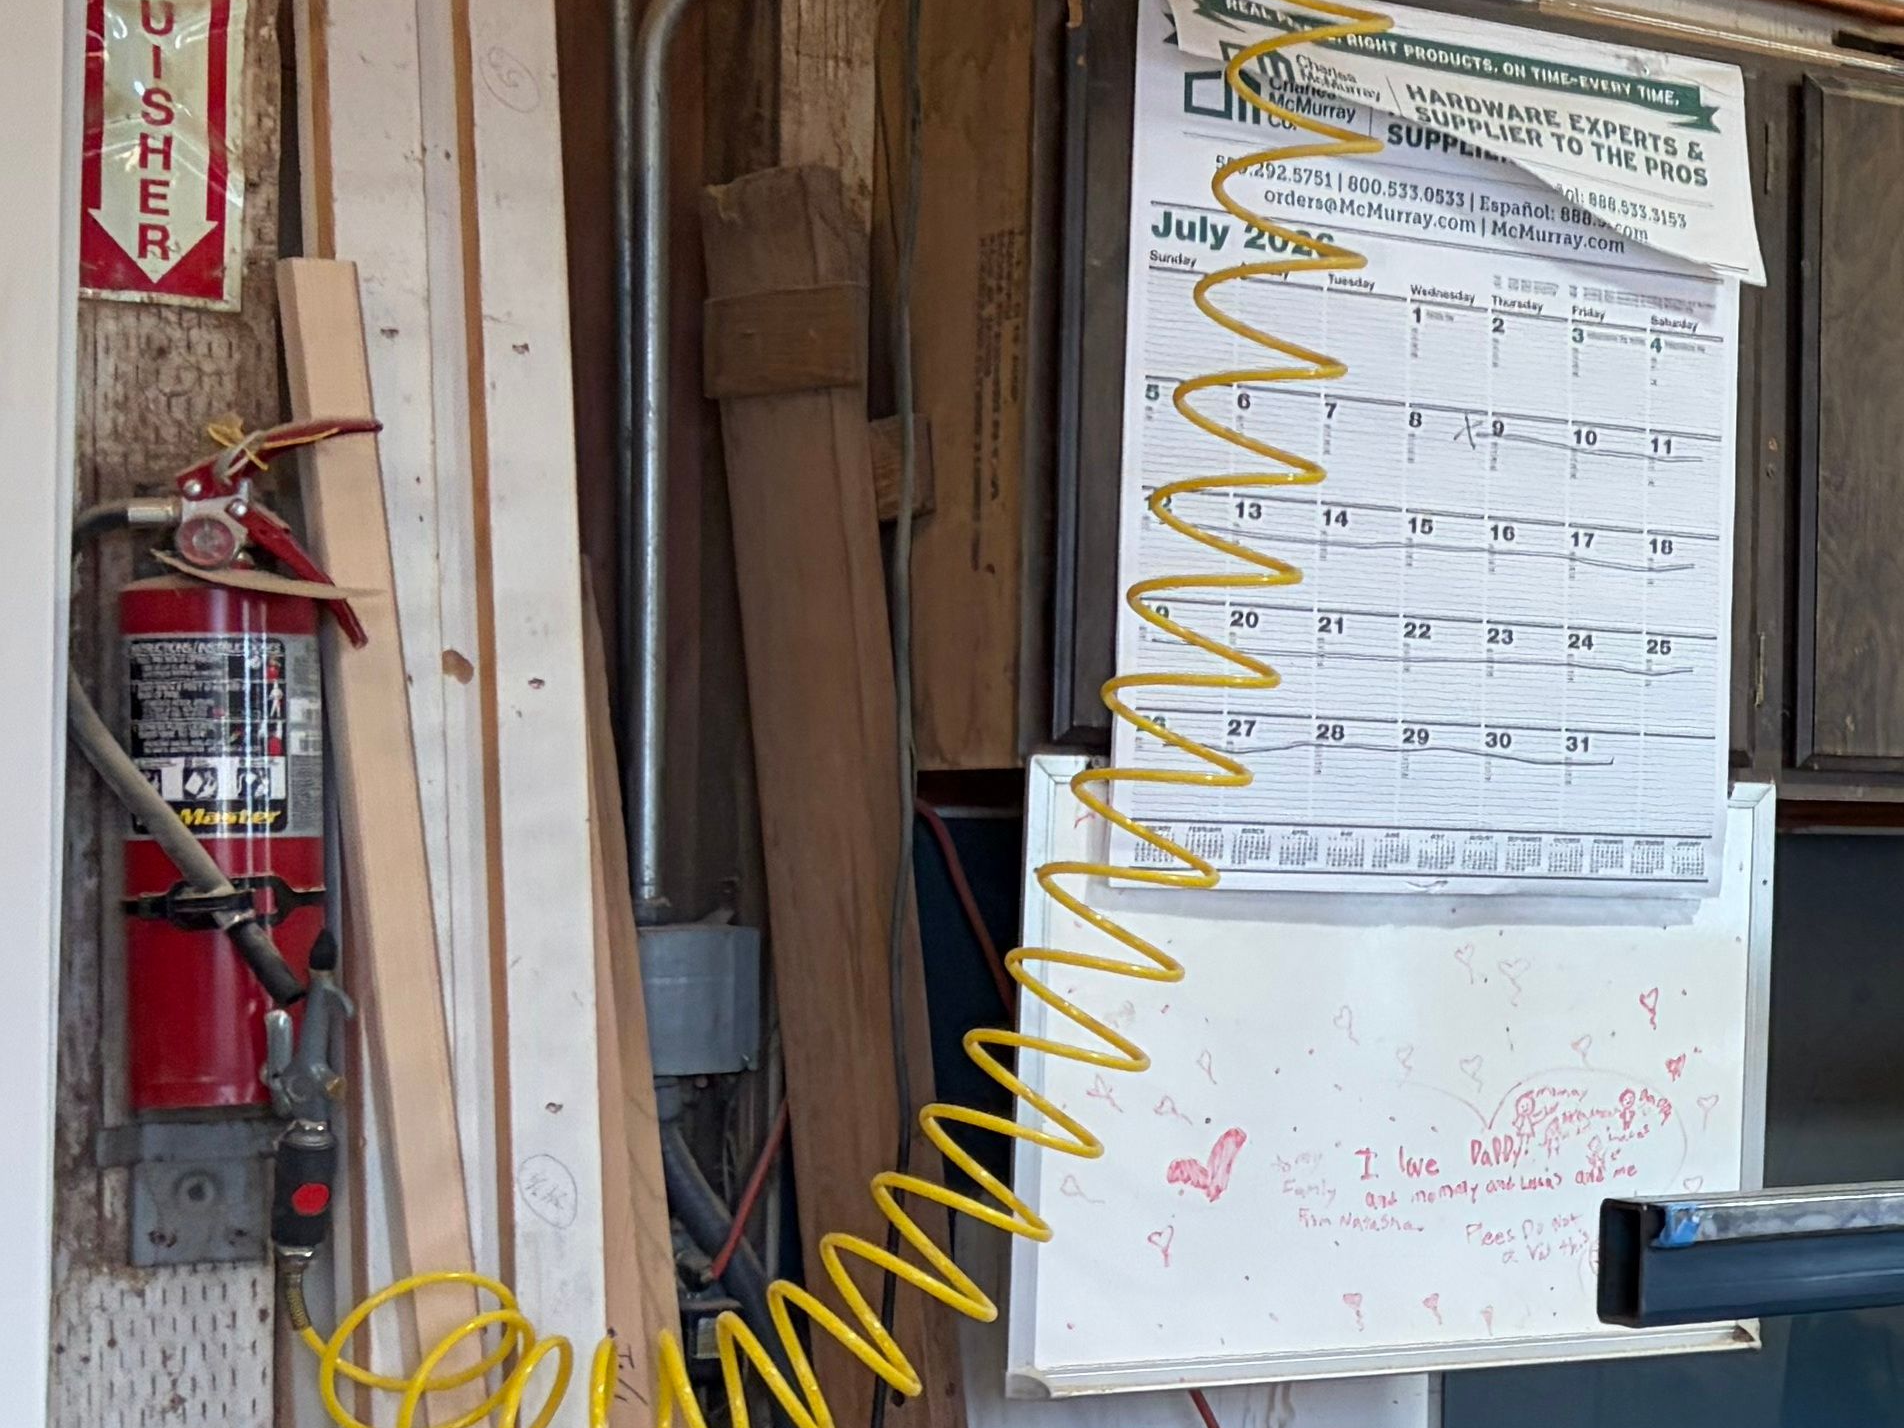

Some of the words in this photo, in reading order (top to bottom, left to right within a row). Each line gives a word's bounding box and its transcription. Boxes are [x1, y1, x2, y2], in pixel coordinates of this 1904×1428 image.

[1347, 34, 1397, 56] RIGHT
[1502, 60, 1526, 78] ON
[1268, 92, 1357, 123] McMurray
[1405, 83, 1559, 128] HARDWARE
[1570, 111, 1679, 156] EXPERTS
[1687, 141, 1704, 162] &
[1414, 107, 1544, 148] SUPPLIER
[1552, 131, 1584, 156] TO
[1591, 140, 1639, 172] THE
[1646, 155, 1710, 188] PROS
[1348, 174, 1466, 208] 800.533.0533
[1151, 210, 1231, 251] July
[1264, 188, 1477, 235] orders@McMurray.com
[1491, 220, 1626, 255] McMurray.com
[1149, 249, 1198, 269] Sunday
[1327, 272, 1376, 292] Tuesday
[1410, 284, 1477, 307] Wednesday
[1491, 294, 1544, 316] Thursday
[1571, 305, 1606, 322] Friday
[1411, 307, 1423, 324] 1
[1491, 317, 1505, 335] 2
[1571, 327, 1585, 344] 3
[1650, 336, 1663, 354] 4
[1145, 384, 1160, 402] 5
[1237, 392, 1251, 410] 6
[1324, 402, 1338, 420] 7
[1408, 411, 1423, 428] 8
[1491, 420, 1504, 439] 9
[1573, 428, 1598, 447] 10
[1651, 437, 1673, 455] 11
[1235, 501, 1263, 520] 13
[1323, 509, 1349, 528] 14
[1408, 516, 1434, 535] 15
[1490, 524, 1516, 542] 16
[1570, 531, 1596, 549] 17
[1648, 538, 1674, 555] 18
[1229, 610, 1260, 629] 20
[1317, 616, 1345, 634] 21
[1403, 621, 1432, 640] 22
[1487, 628, 1514, 646] 23
[1567, 633, 1594, 651] 24
[1646, 639, 1672, 656] 25
[1227, 719, 1257, 738] 27
[1316, 723, 1345, 741] 28
[1402, 727, 1430, 746] 29
[1485, 732, 1512, 749] 30
[1565, 736, 1590, 753] 31
[1354, 1146, 1380, 1182] I
[1574, 1163, 1606, 1186] and
